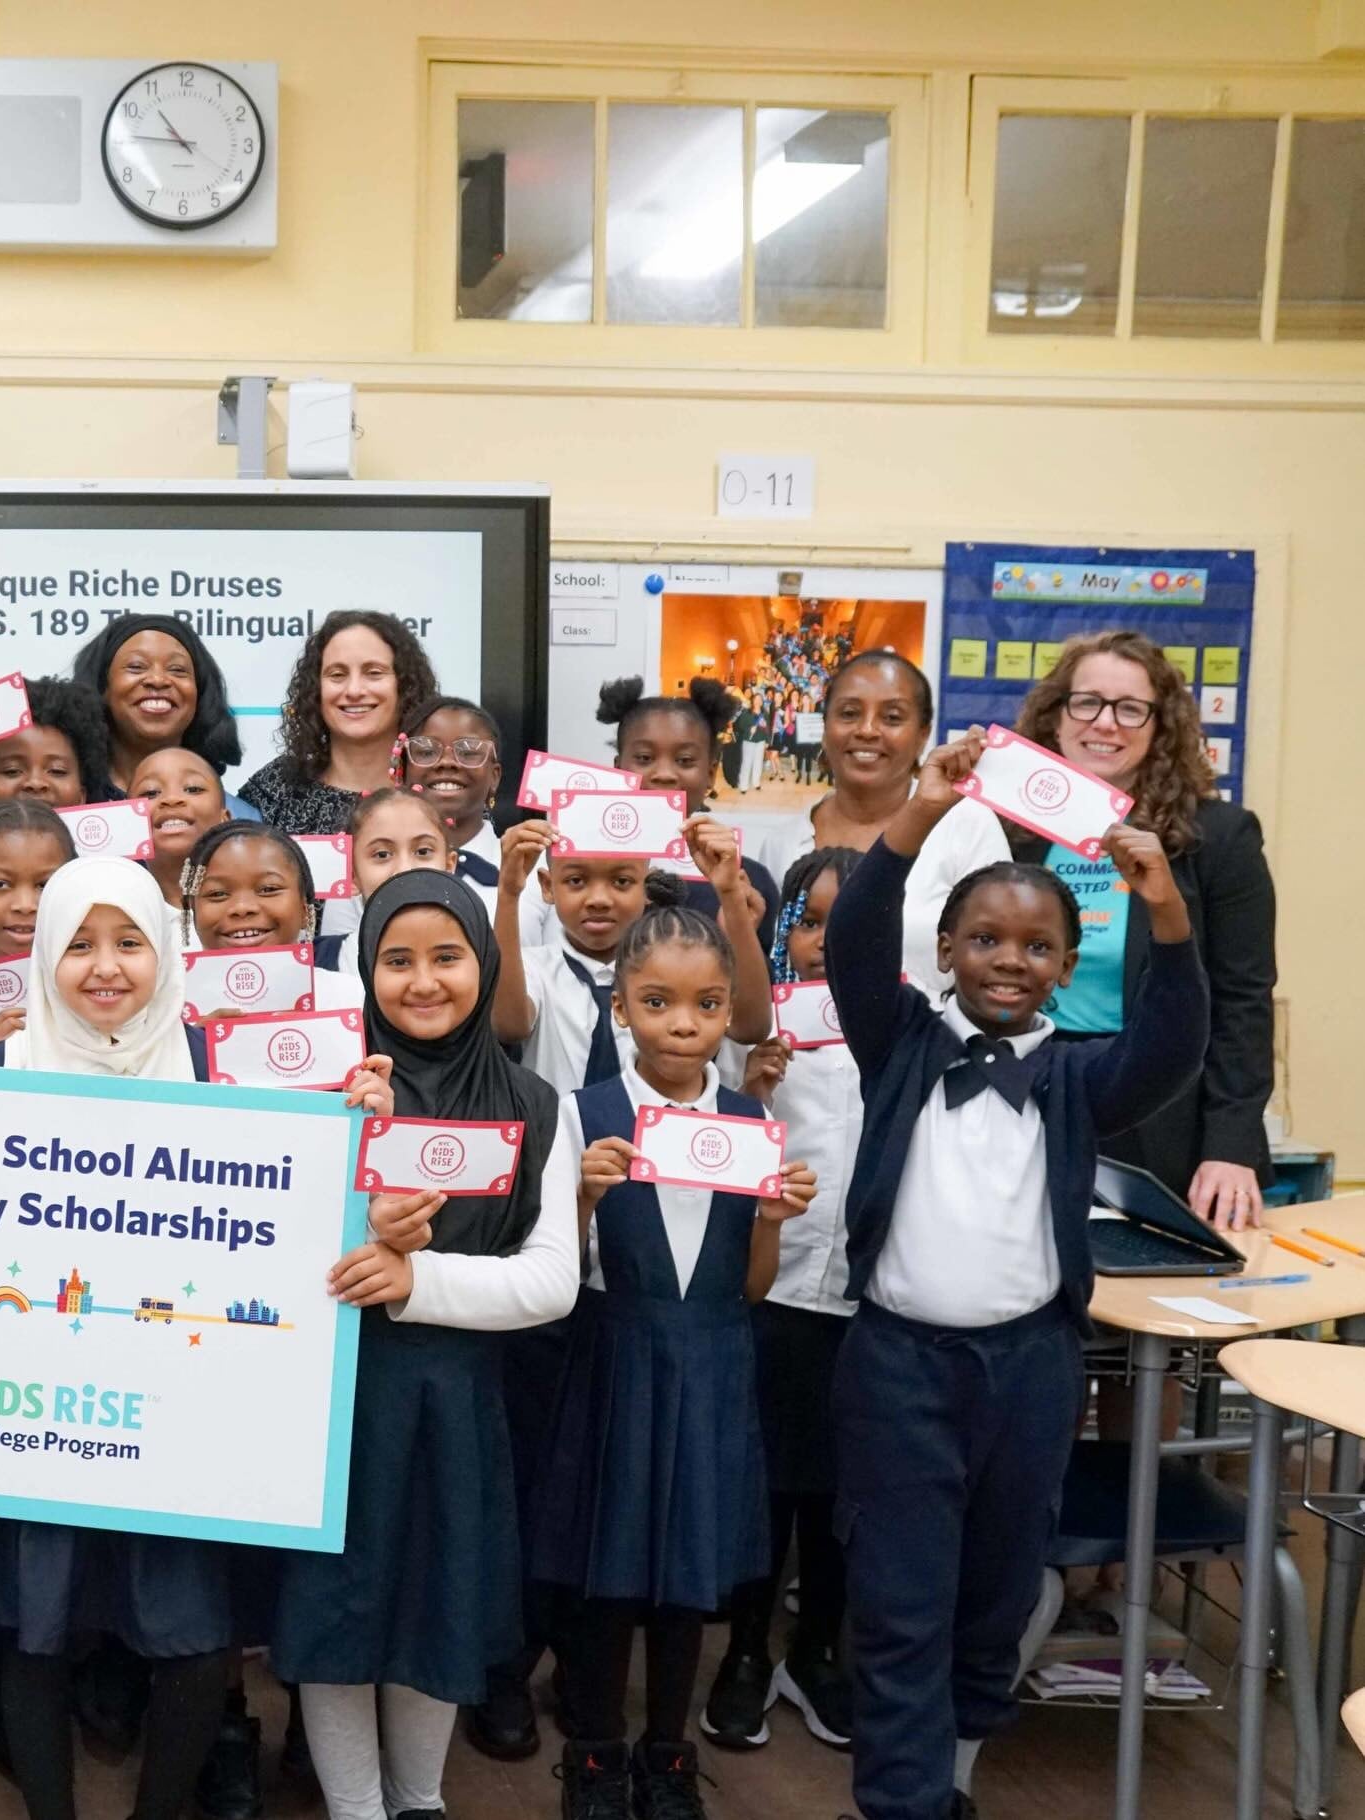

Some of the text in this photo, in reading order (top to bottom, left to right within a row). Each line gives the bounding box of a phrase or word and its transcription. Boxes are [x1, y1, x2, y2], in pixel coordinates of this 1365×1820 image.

[178, 71, 194, 87] 12
[145, 80, 158, 95] 11
[216, 82, 222, 97] 1
[123, 102, 138, 117] 10
[235, 106, 246, 122] 2
[244, 138, 253, 154] 3
[123, 167, 132, 183] 8
[234, 170, 243, 184] 4
[147, 190, 155, 206] 7
[211, 192, 220, 208] 5
[179, 200, 188, 216] 6
[69, 569, 159, 597] Riche
[170, 571, 283, 597] Druses
[554, 573, 606, 588] School:
[1081, 573, 1120, 591] May
[31, 609, 89, 636] 189
[562, 625, 592, 636] Class:
[1214, 698, 1223, 712] 2
[3, 1135, 135, 1178] School
[145, 1147, 292, 1190] Alumni
[17, 1192, 276, 1252] Scholarships
[43, 1432, 141, 1460] Program
